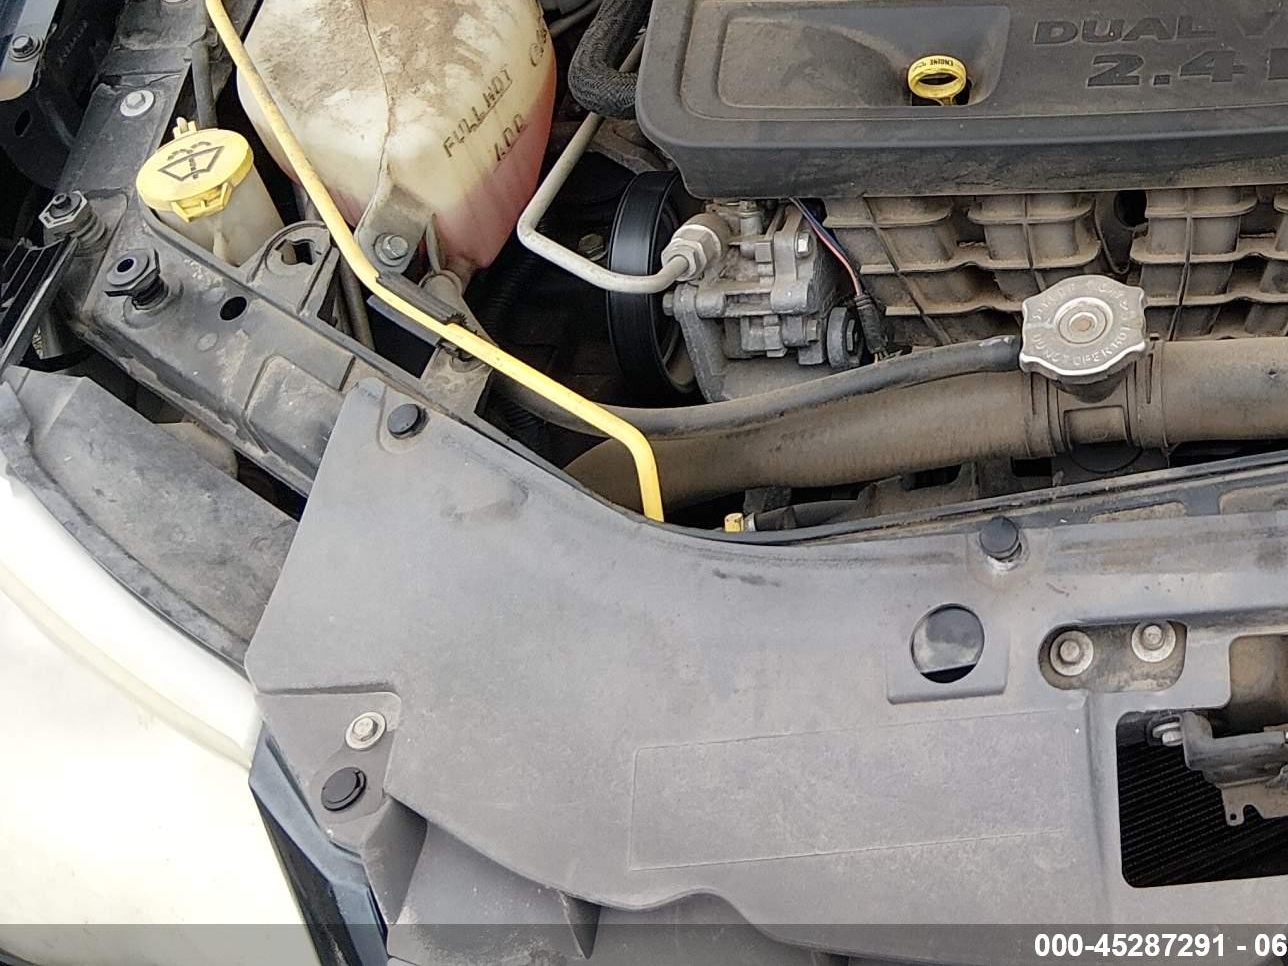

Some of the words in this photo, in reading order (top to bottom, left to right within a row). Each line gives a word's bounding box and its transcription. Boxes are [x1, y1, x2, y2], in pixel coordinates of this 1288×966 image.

[1032, 17, 1217, 45] DUAL
[1086, 49, 1248, 88] 2.4
[442, 106, 486, 159] FULL
[482, 64, 513, 109] HOT
